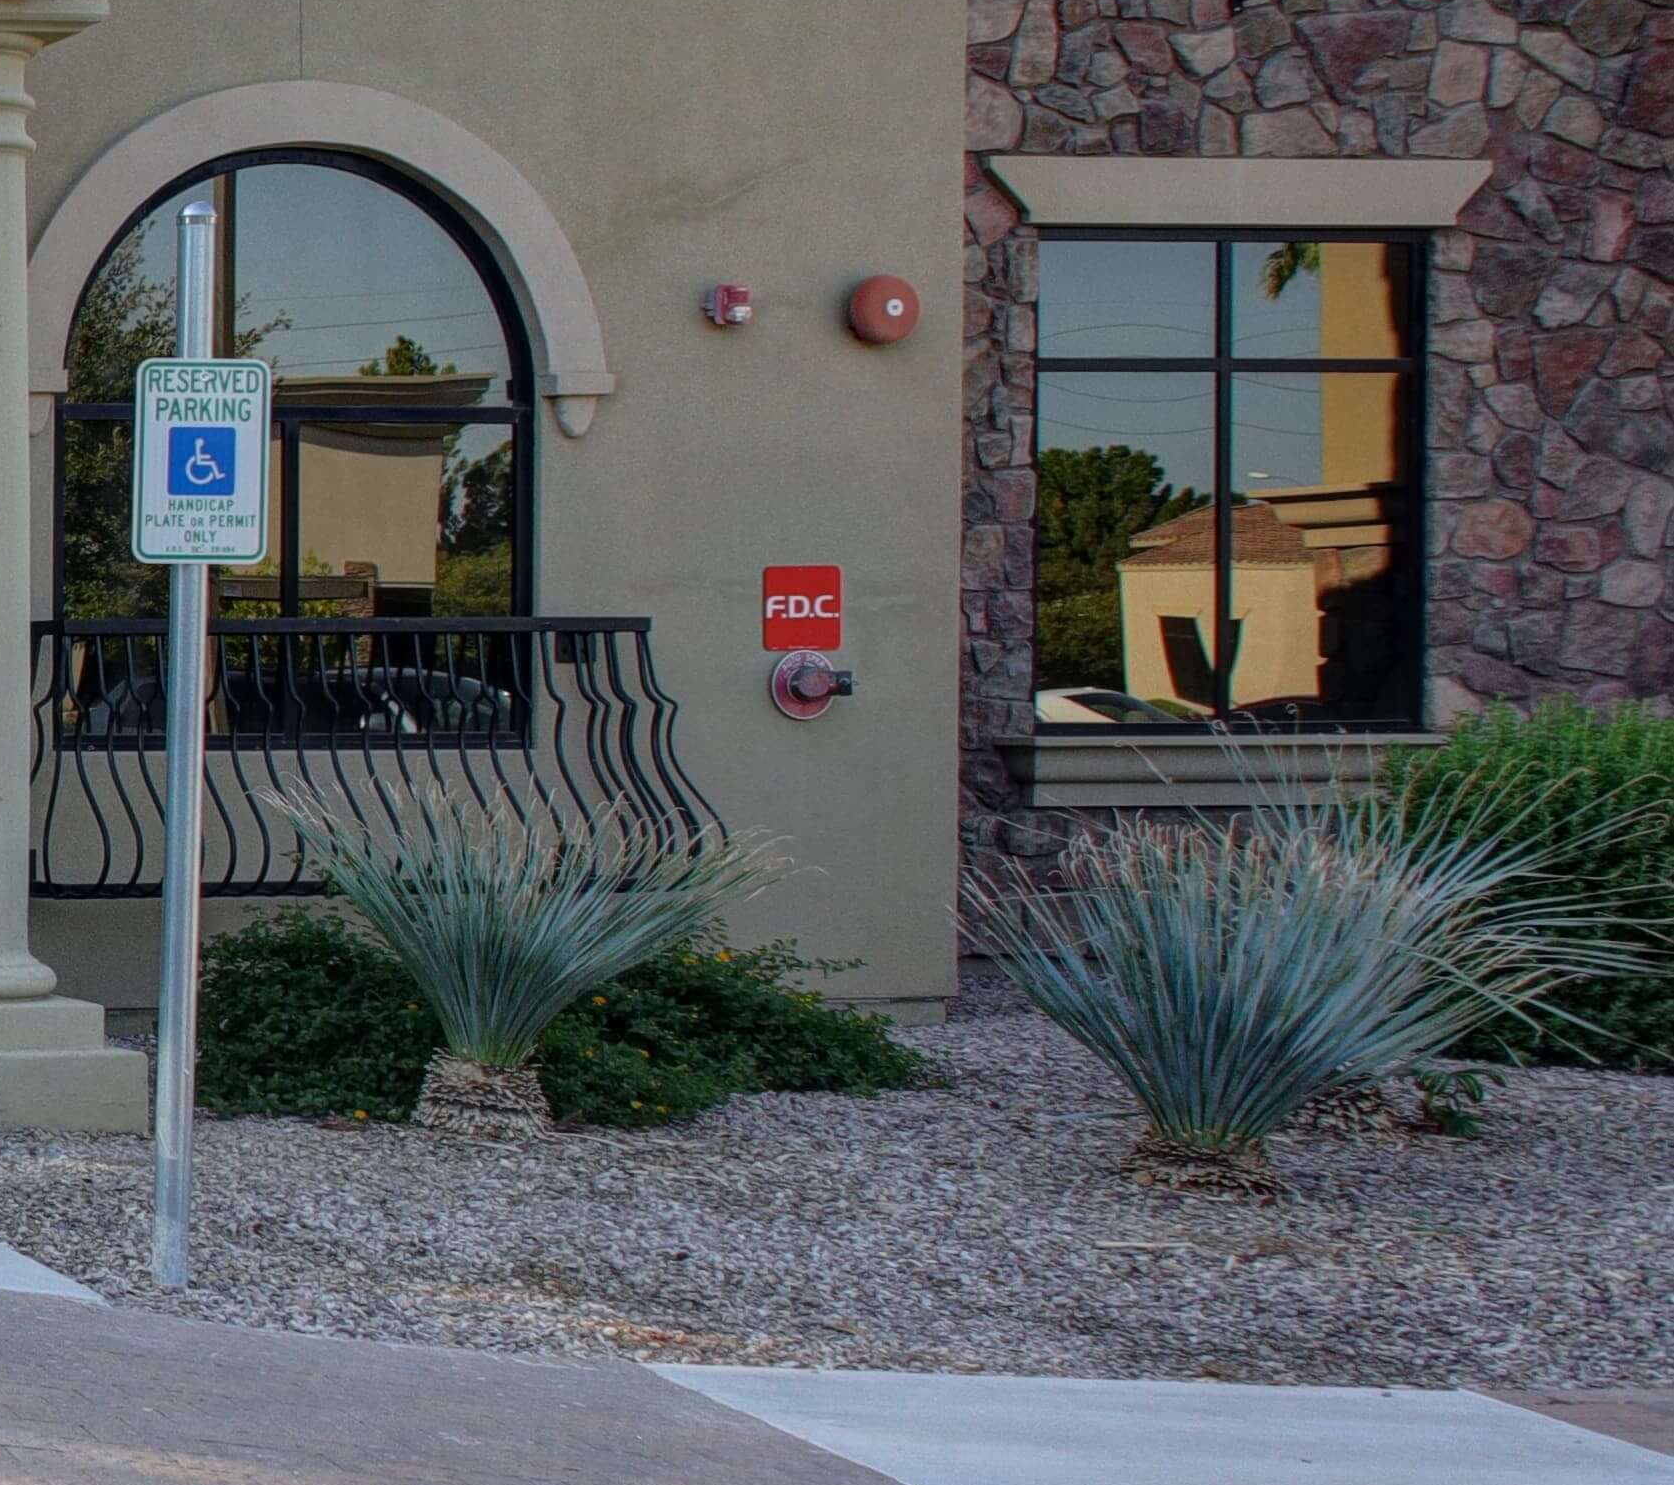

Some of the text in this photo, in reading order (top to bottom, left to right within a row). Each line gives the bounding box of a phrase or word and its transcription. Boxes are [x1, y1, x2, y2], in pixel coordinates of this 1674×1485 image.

[148, 369, 260, 393] RESERVED
[155, 398, 252, 422] PARKING
[168, 499, 234, 511] HANDICAP
[145, 514, 257, 528] PLATE OR PERMIT
[184, 530, 217, 543] ONLY
[765, 595, 840, 618] F.D.C.
